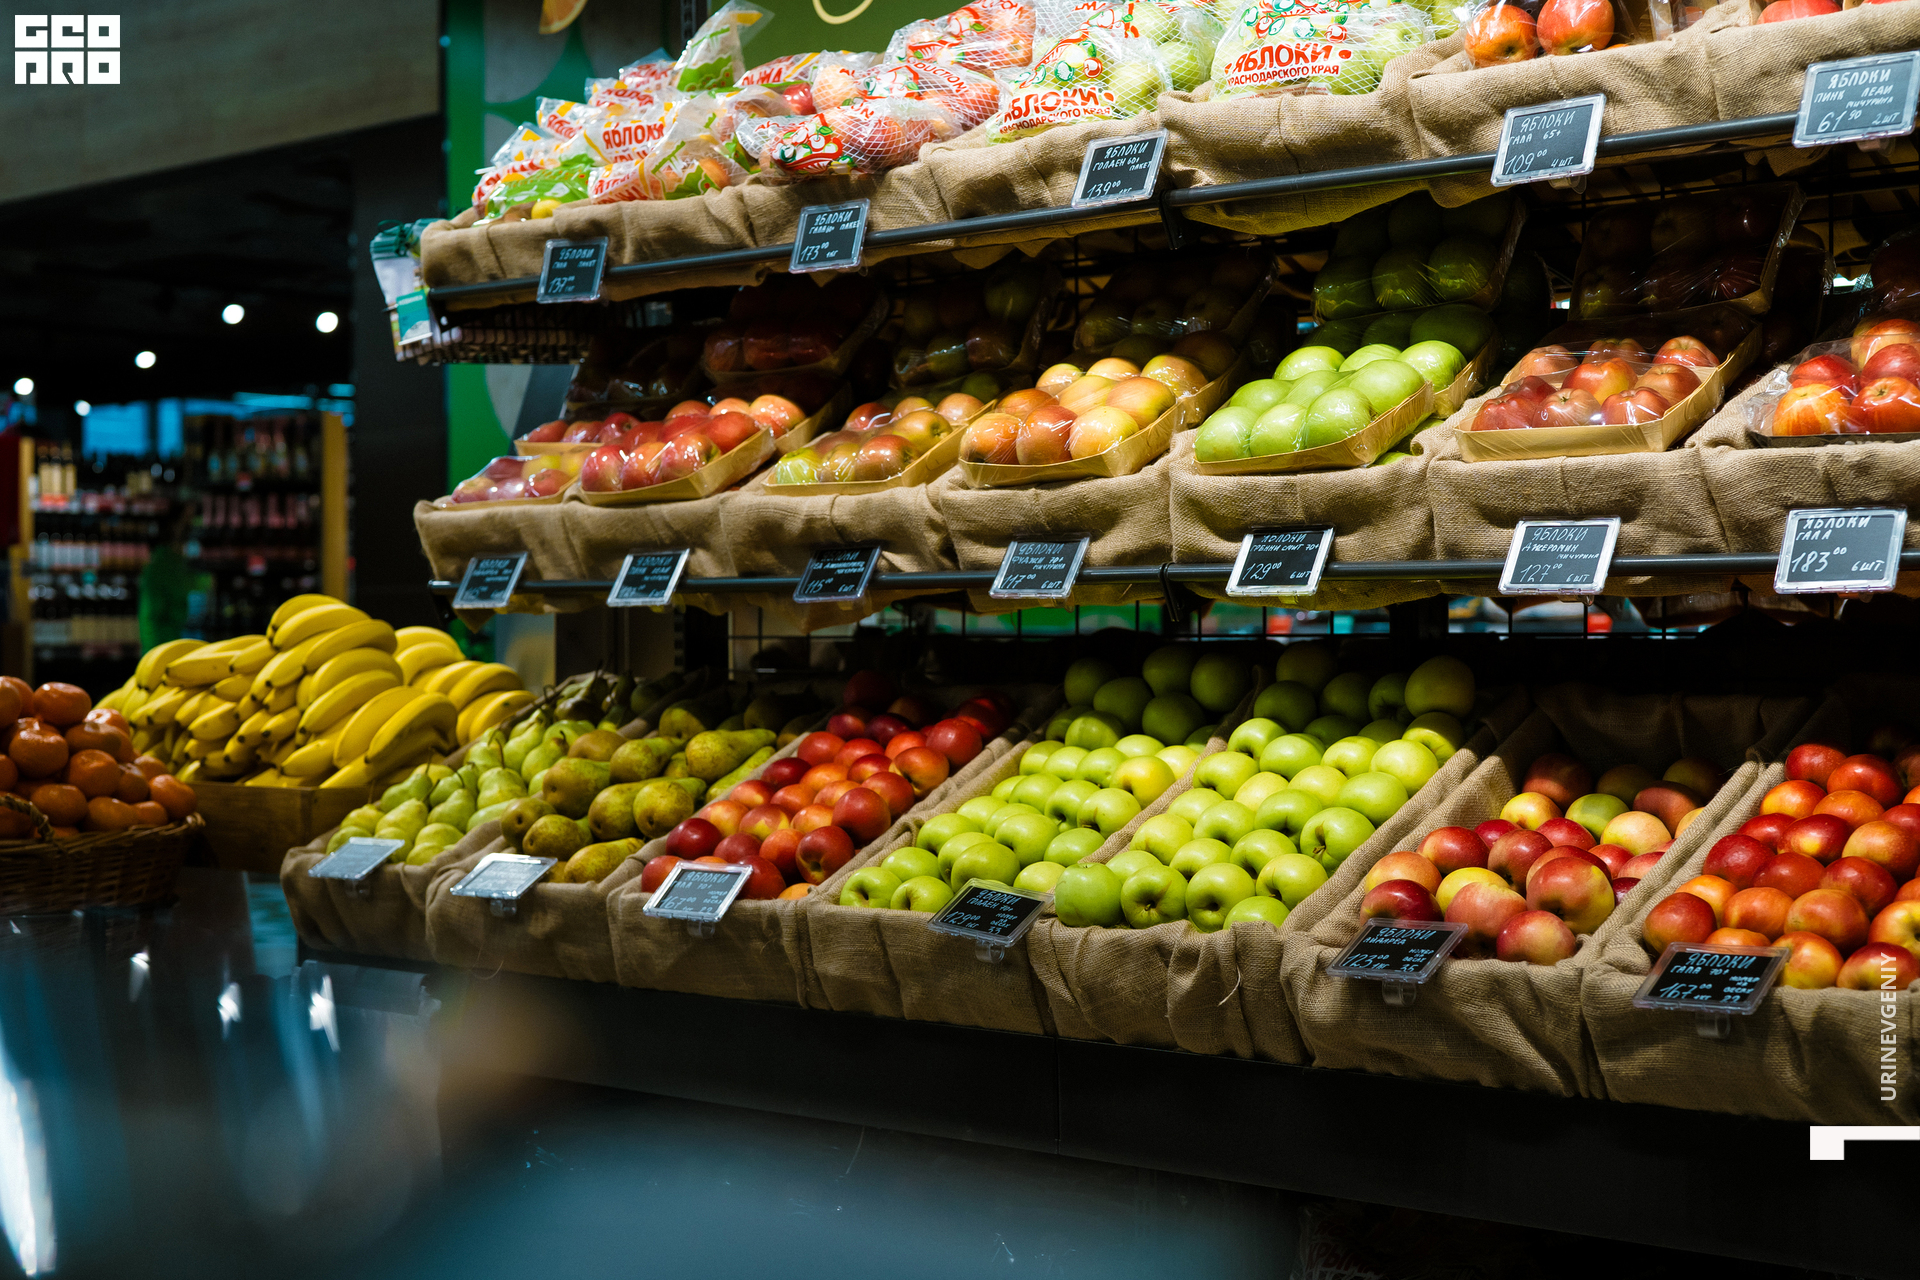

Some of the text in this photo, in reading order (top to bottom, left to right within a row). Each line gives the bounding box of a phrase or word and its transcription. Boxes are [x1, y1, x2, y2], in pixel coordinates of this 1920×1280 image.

[1311, 64, 1340, 76] КРАЯ
[1828, 69, 1892, 89] ЯБЛОКИ
[1814, 85, 1893, 103] ПИНК ЛЕДИ
[1846, 97, 1894, 109] МИЧУРИНА
[1520, 110, 1576, 132] ЯБЛОКИ
[1509, 133, 1533, 145] ГАЛА
[1104, 142, 1149, 159] ЯБЛОКИ
[1093, 157, 1127, 171] ГОЛДЕН
[814, 210, 853, 226] ЯБЛОКИ
[559, 248, 594, 260] ЯБЛОКИ
[1803, 515, 1871, 529] ЯБЛОКИ
[1532, 527, 1589, 541] ЯБЛОКИ
[1796, 529, 1832, 540] ГАЛА
[1019, 543, 1064, 555] ЯБЛОКИ
[1521, 541, 1579, 552] ДЖЕРОМИН
[685, 871, 730, 884] ЯБЛОКИ
[976, 889, 1022, 906] ЯБЛОКИ
[1376, 927, 1437, 941] ЯБЛОКИ
[1686, 952, 1756, 969] ЯБЛОКИ
[1670, 965, 1702, 975] ГАЛА
